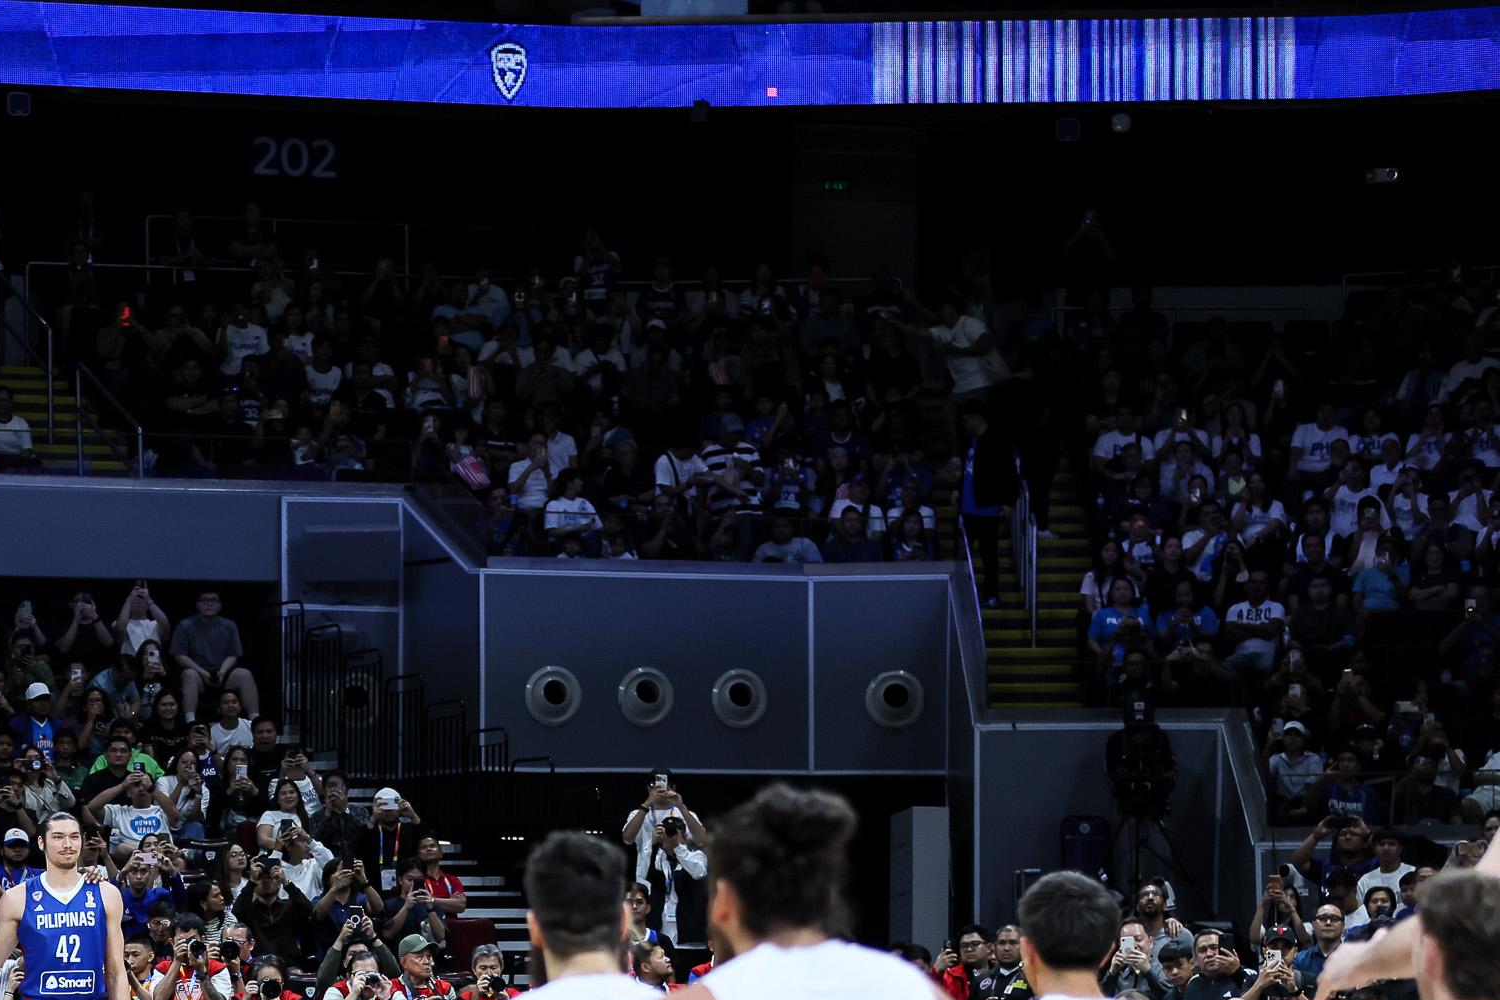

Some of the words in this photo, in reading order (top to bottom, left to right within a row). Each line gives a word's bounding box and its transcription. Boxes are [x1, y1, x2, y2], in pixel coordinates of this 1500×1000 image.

[252, 136, 336, 179] 202
[36, 910, 96, 929] PILIPINAS
[55, 934, 81, 963] 42
[58, 976, 93, 989] Smart
